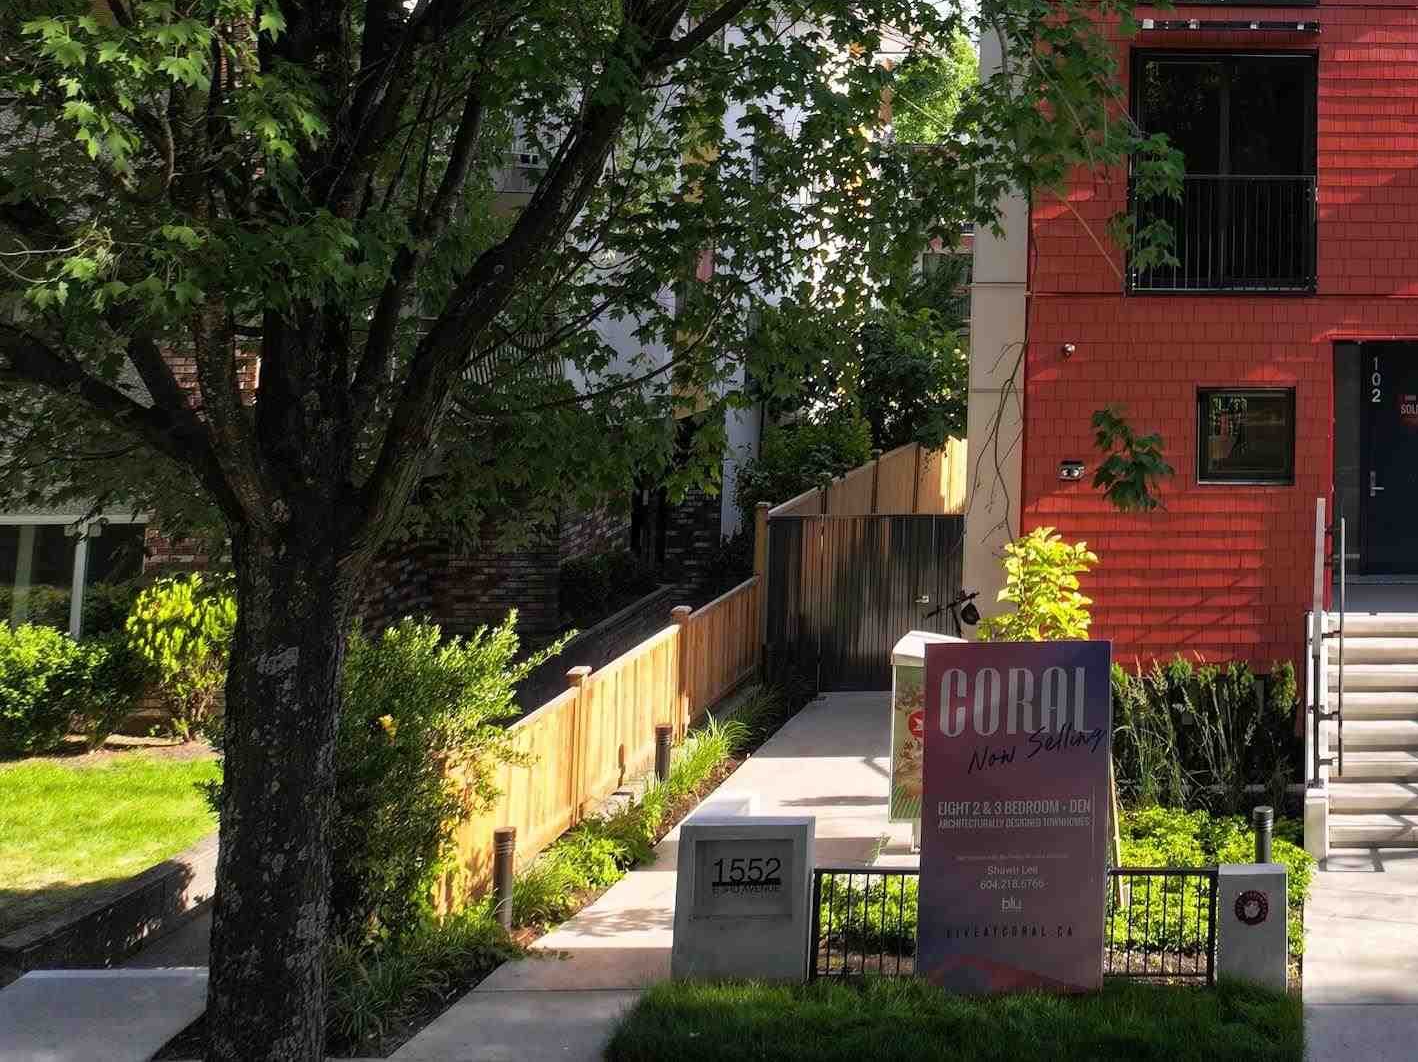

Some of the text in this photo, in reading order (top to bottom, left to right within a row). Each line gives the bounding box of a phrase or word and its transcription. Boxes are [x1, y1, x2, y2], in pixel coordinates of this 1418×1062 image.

[1372, 356, 1381, 403] 102
[939, 667, 1096, 737] CORAL
[968, 722, 1106, 774] Now Selling
[938, 801, 971, 815] EIGHT
[973, 801, 981, 815] 2
[983, 801, 992, 815] &
[994, 801, 1002, 814] 3
[1004, 799, 1059, 814] BEDROOM
[1070, 799, 1091, 813] DEN
[714, 857, 781, 883] 1552
